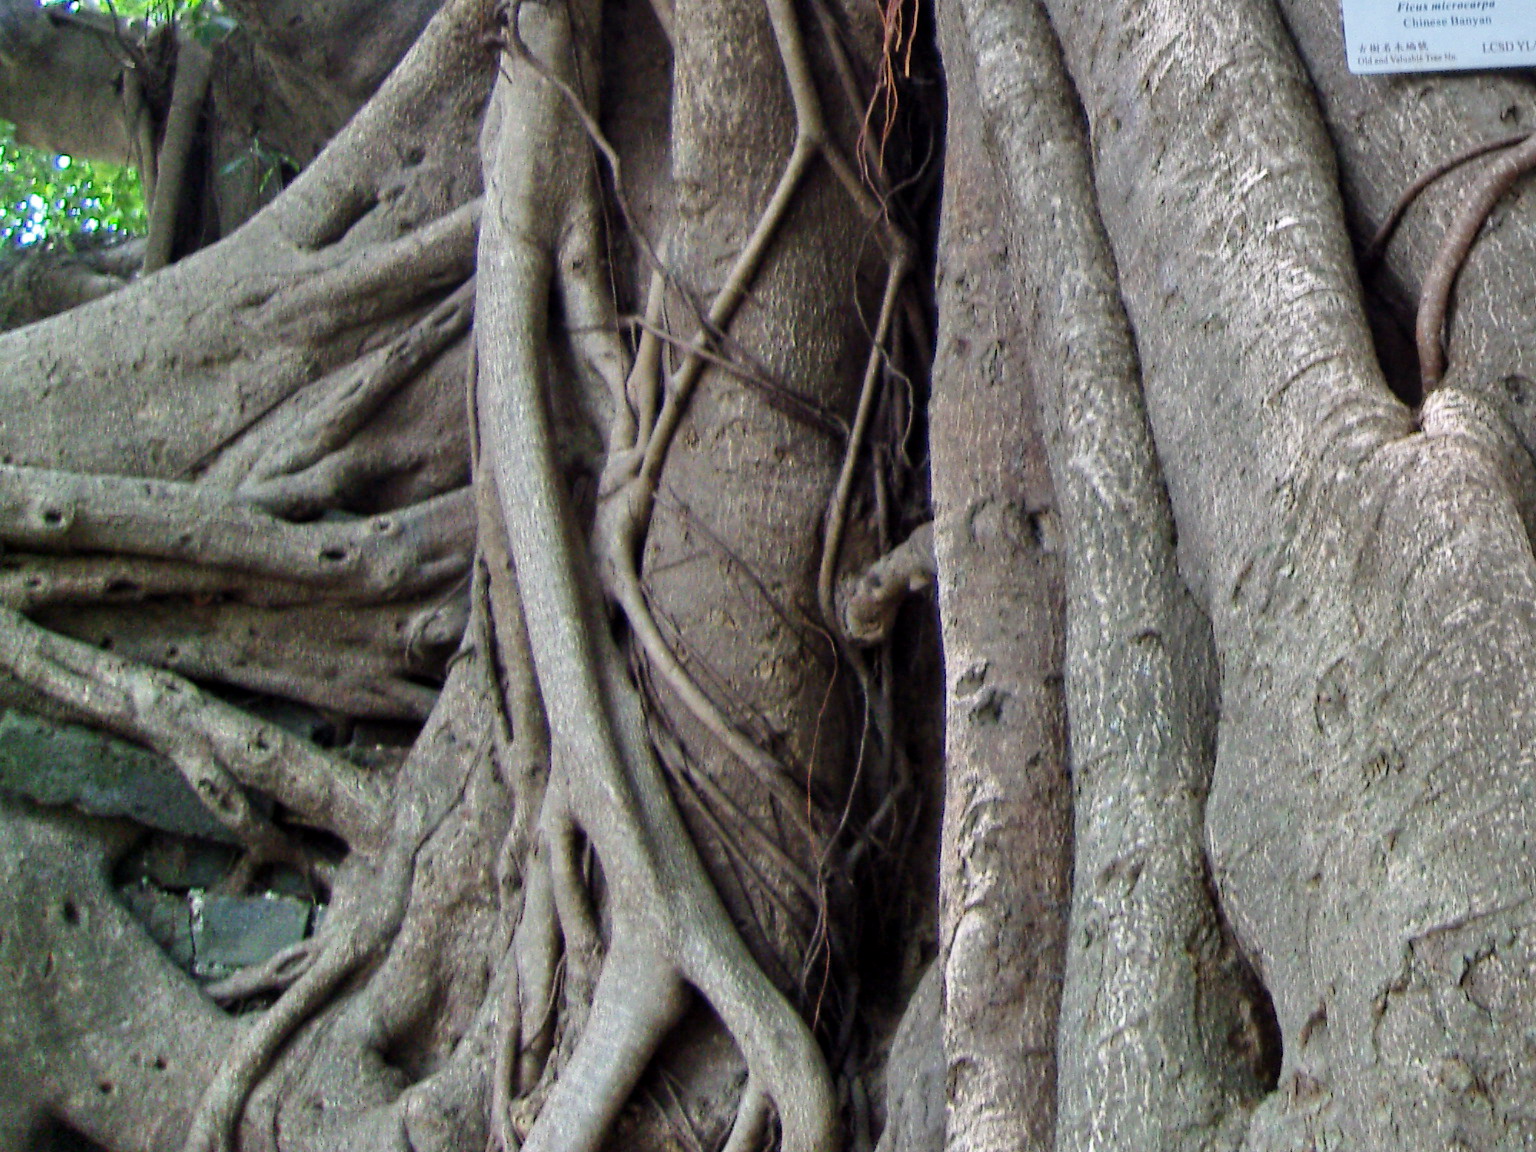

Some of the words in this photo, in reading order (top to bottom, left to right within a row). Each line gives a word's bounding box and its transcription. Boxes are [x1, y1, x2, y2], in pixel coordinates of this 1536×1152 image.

[1397, 1, 1429, 13] Ficus
[1431, 0, 1496, 12] microcarpa
[1403, 16, 1447, 28] Chinese
[1450, 14, 1492, 26] Banyan
[1482, 40, 1514, 54] LCSD
